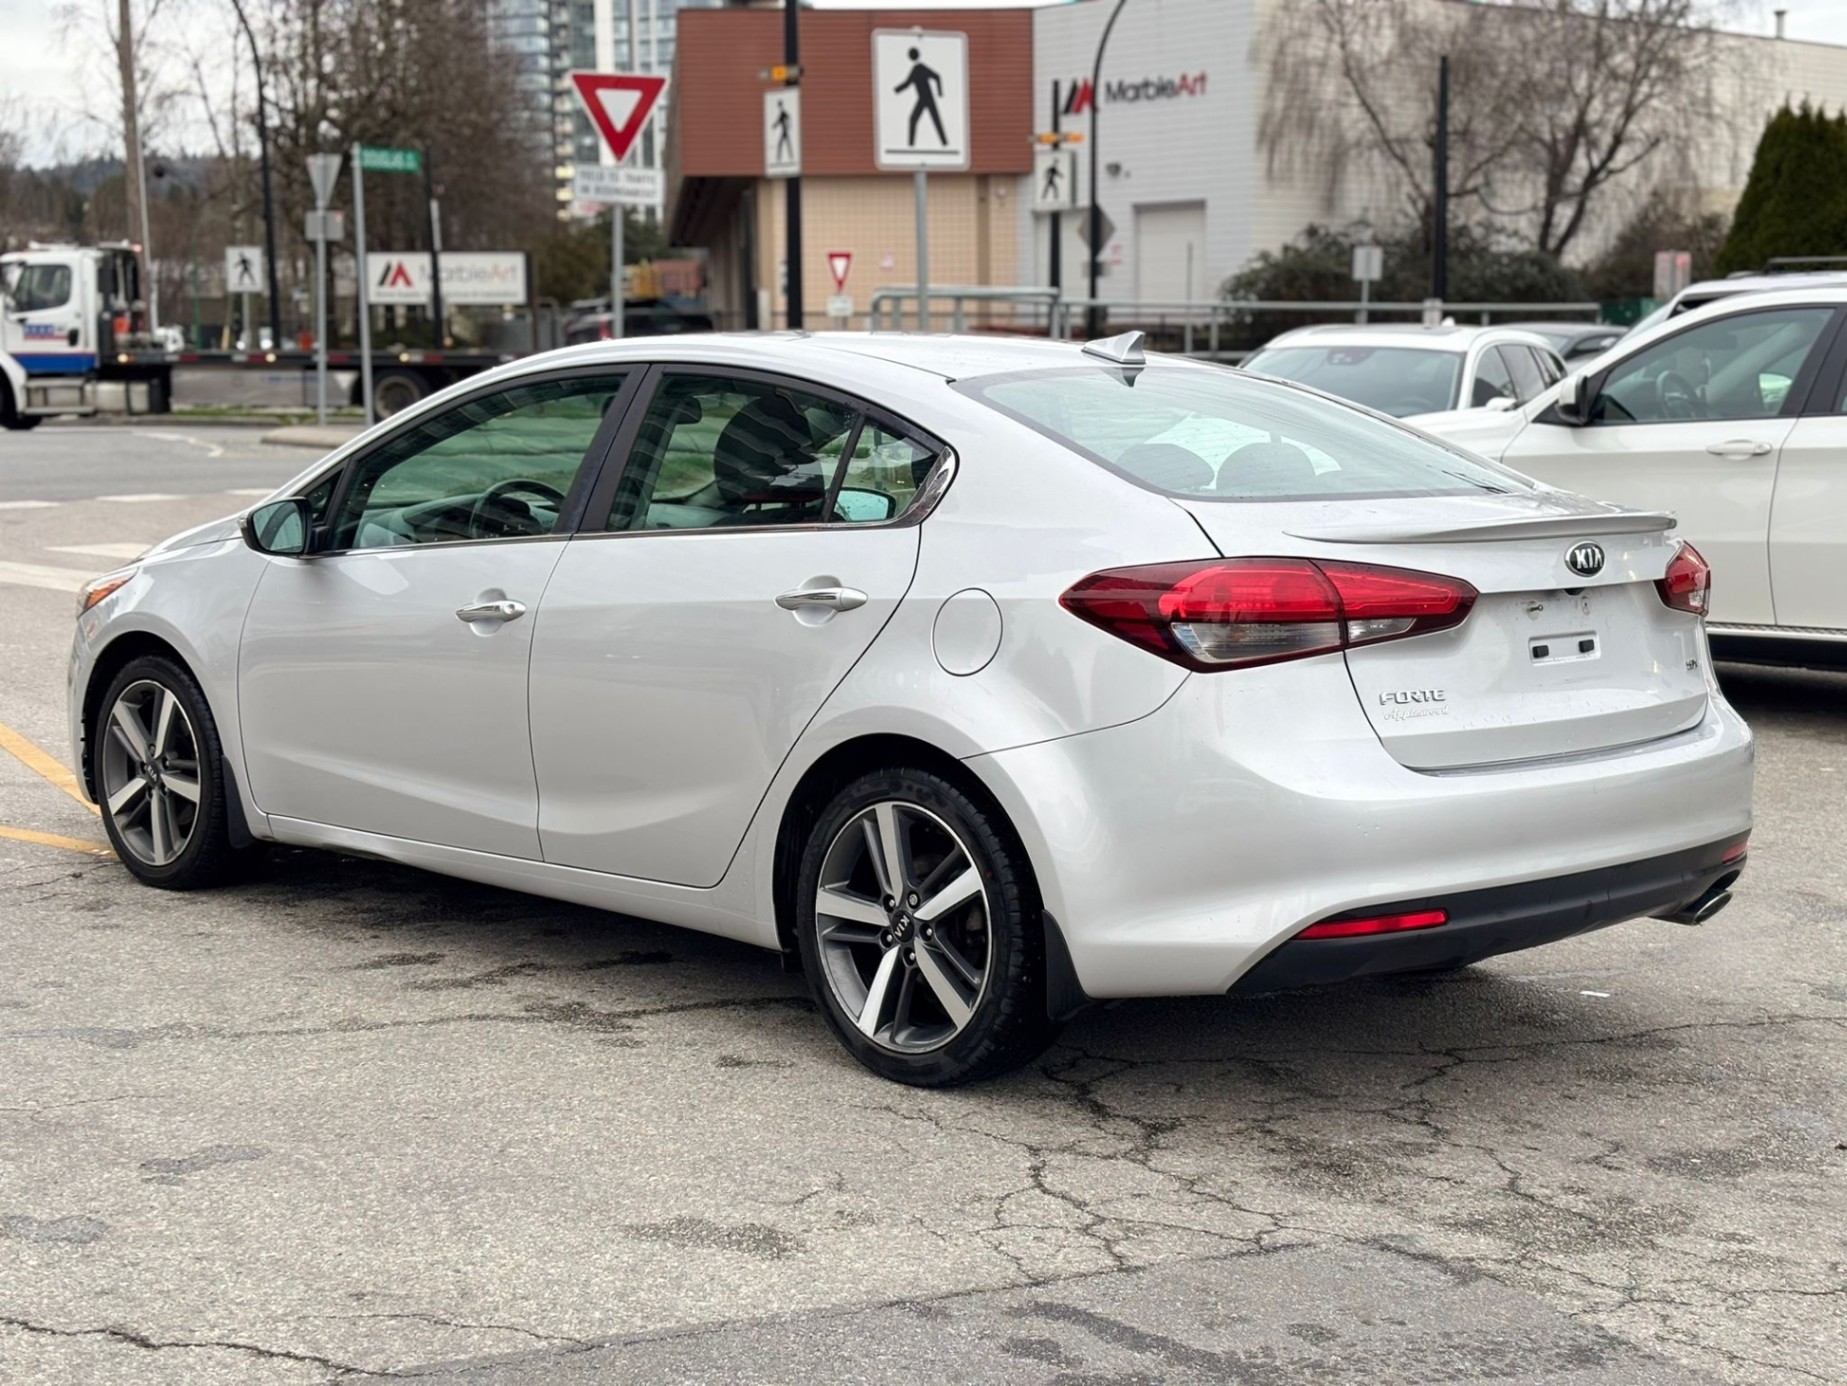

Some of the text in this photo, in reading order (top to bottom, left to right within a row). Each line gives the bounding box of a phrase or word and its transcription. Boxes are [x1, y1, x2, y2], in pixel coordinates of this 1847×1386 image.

[1105, 71, 1207, 102] MarbleArt
[1574, 546, 1604, 570] KIA
[1379, 689, 1447, 706] FORTE
[894, 914, 910, 937] KIA
